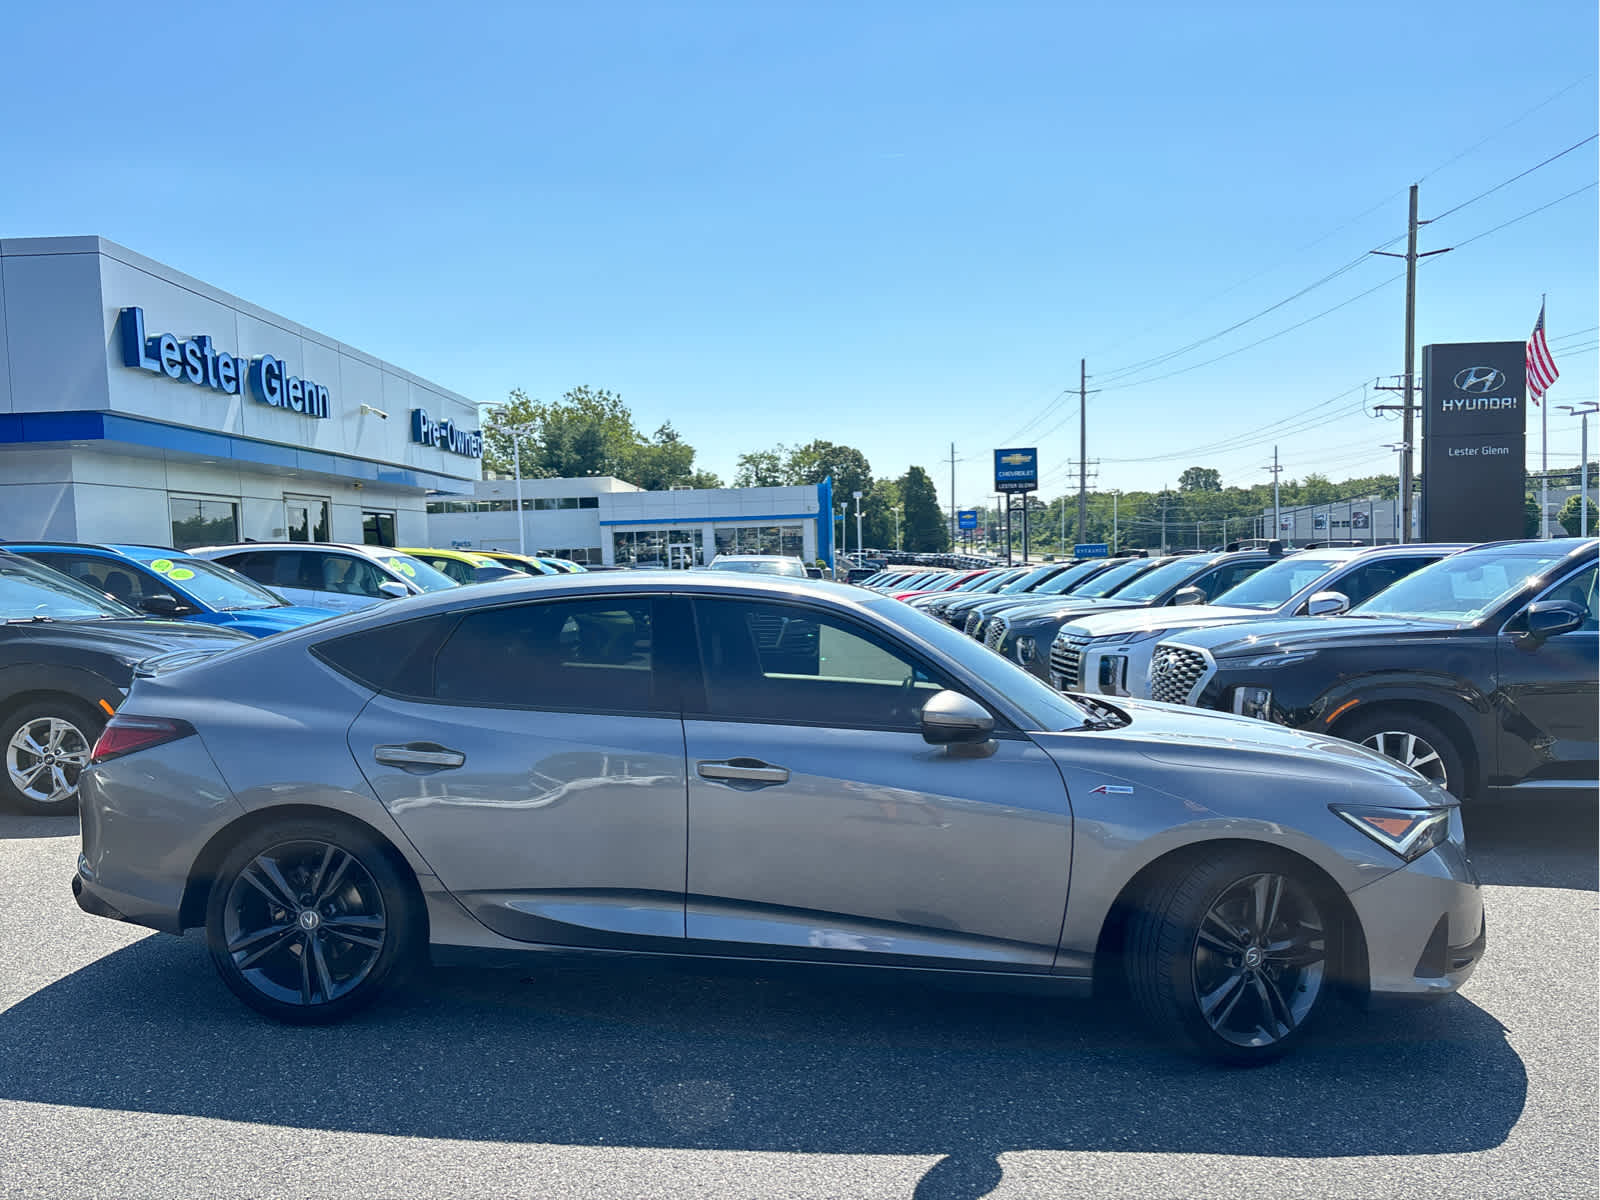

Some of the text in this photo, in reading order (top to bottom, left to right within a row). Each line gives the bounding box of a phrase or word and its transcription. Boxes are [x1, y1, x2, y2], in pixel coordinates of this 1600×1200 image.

[119, 305, 330, 418] Lester Glenn
[1441, 397, 1517, 412] HYUNDAI
[411, 408, 484, 459] Pre-Owned
[1448, 446, 1509, 457] Lester Glenn
[998, 470, 1035, 478] CHEVROLET
